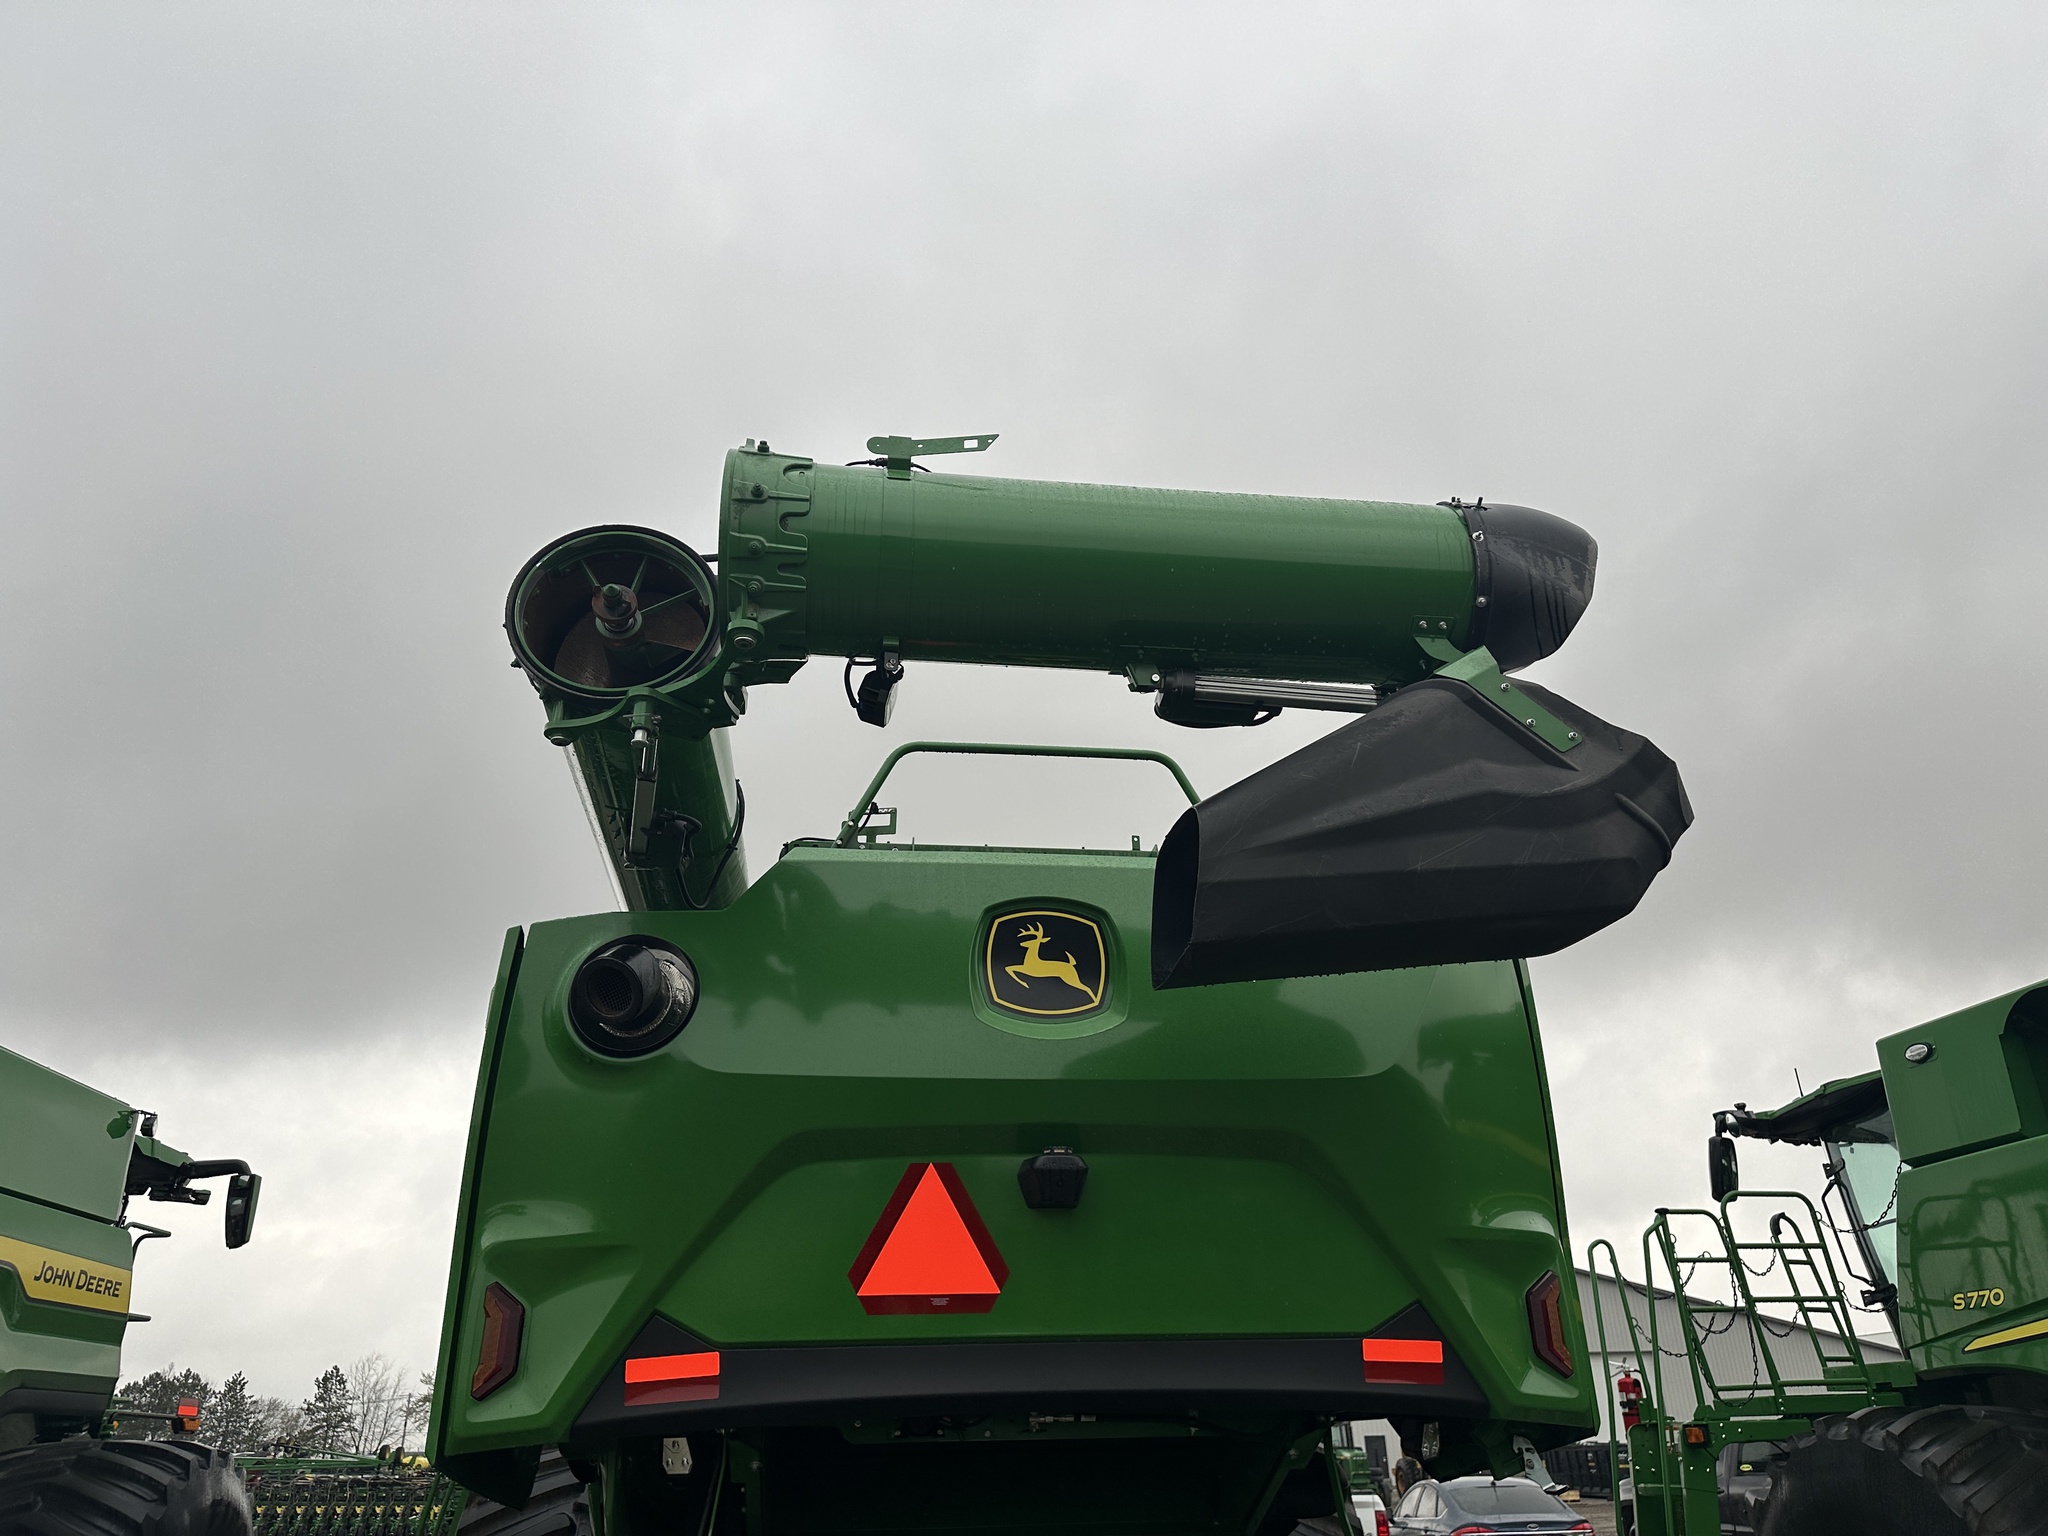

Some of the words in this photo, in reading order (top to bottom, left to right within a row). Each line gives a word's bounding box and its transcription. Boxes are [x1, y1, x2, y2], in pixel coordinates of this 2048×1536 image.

[34, 1261, 75, 1288] JOHN
[75, 1269, 122, 1298] DEERE
[1953, 1287, 2005, 1311] S770
